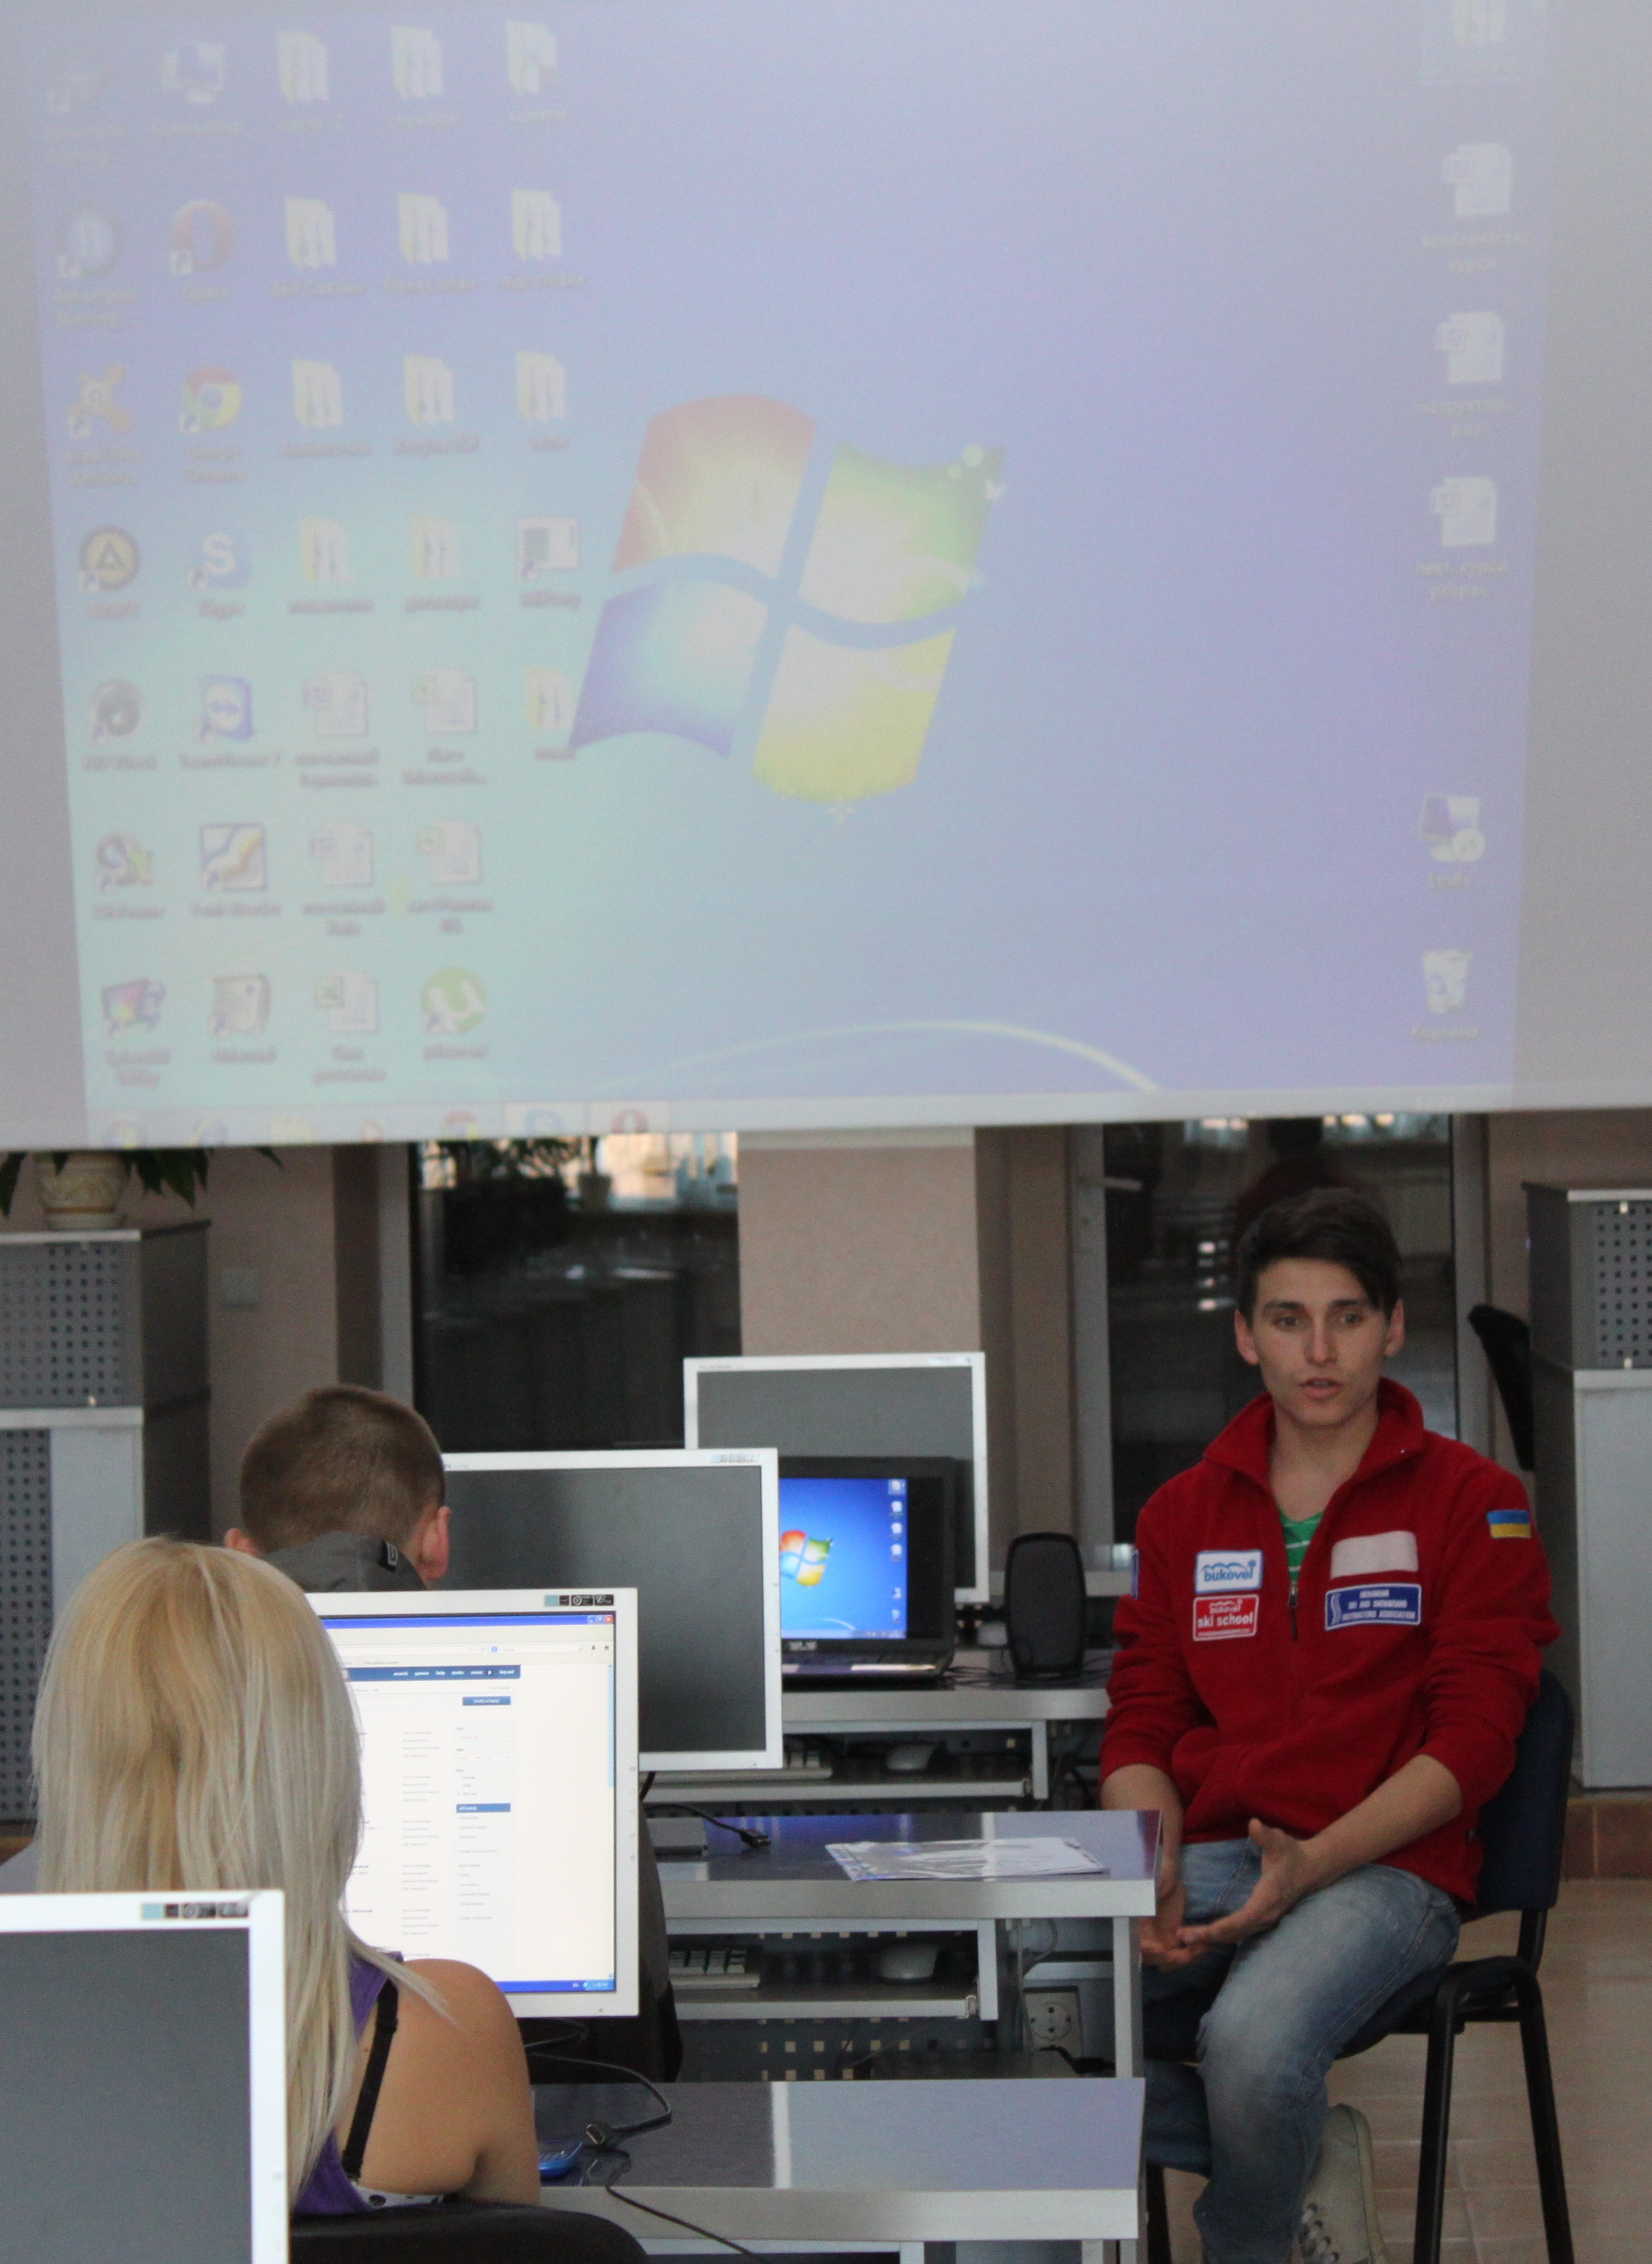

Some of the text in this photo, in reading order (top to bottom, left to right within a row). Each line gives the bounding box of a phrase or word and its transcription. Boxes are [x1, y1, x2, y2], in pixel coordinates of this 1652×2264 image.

[1203, 1564, 1255, 1582] bukovel
[1197, 1611, 1253, 1628] ski school
